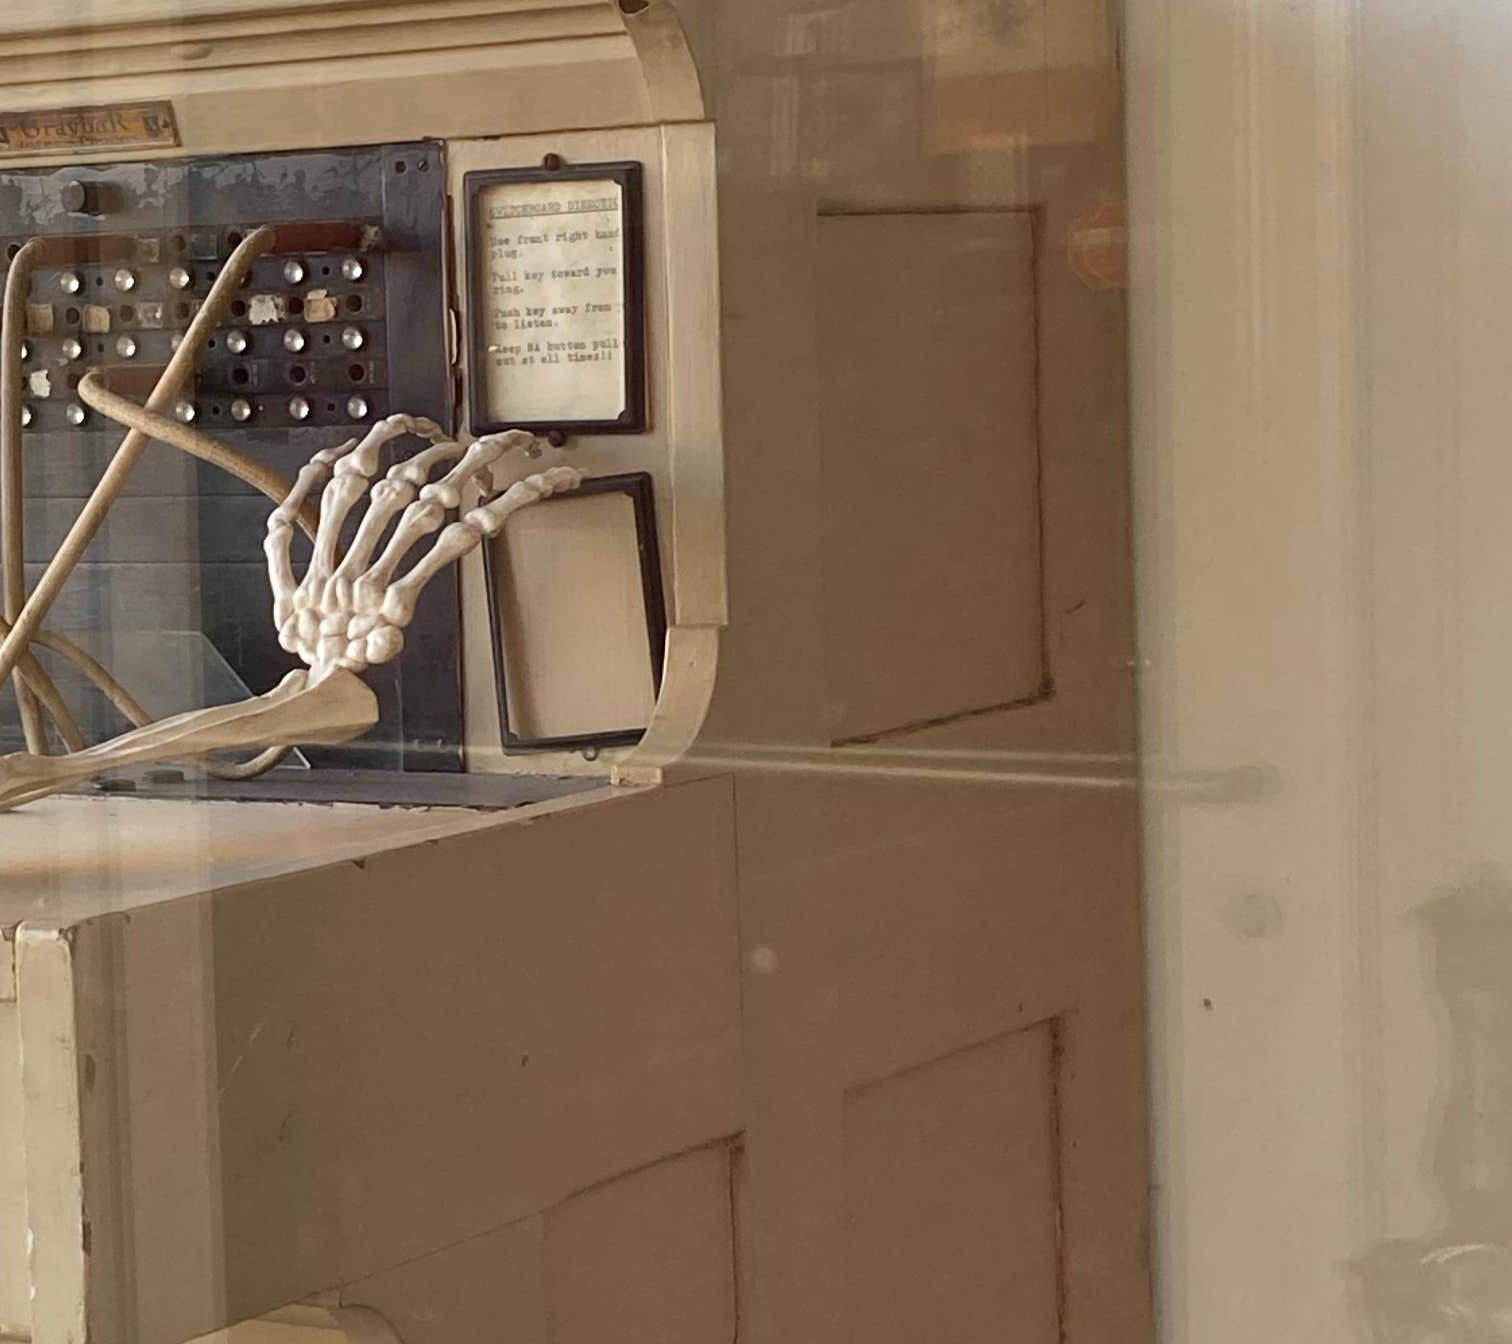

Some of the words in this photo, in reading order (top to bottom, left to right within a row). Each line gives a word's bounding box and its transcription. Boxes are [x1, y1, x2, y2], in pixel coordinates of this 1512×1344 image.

[518, 234, 548, 245] front
[556, 231, 588, 243] right
[492, 271, 518, 283] Pull
[524, 269, 545, 282] key
[551, 266, 590, 279] toward
[596, 267, 617, 278] you
[494, 307, 520, 318] Push
[526, 306, 545, 318] key
[552, 306, 578, 316] away
[585, 302, 612, 313] from
[547, 341, 586, 352] button
